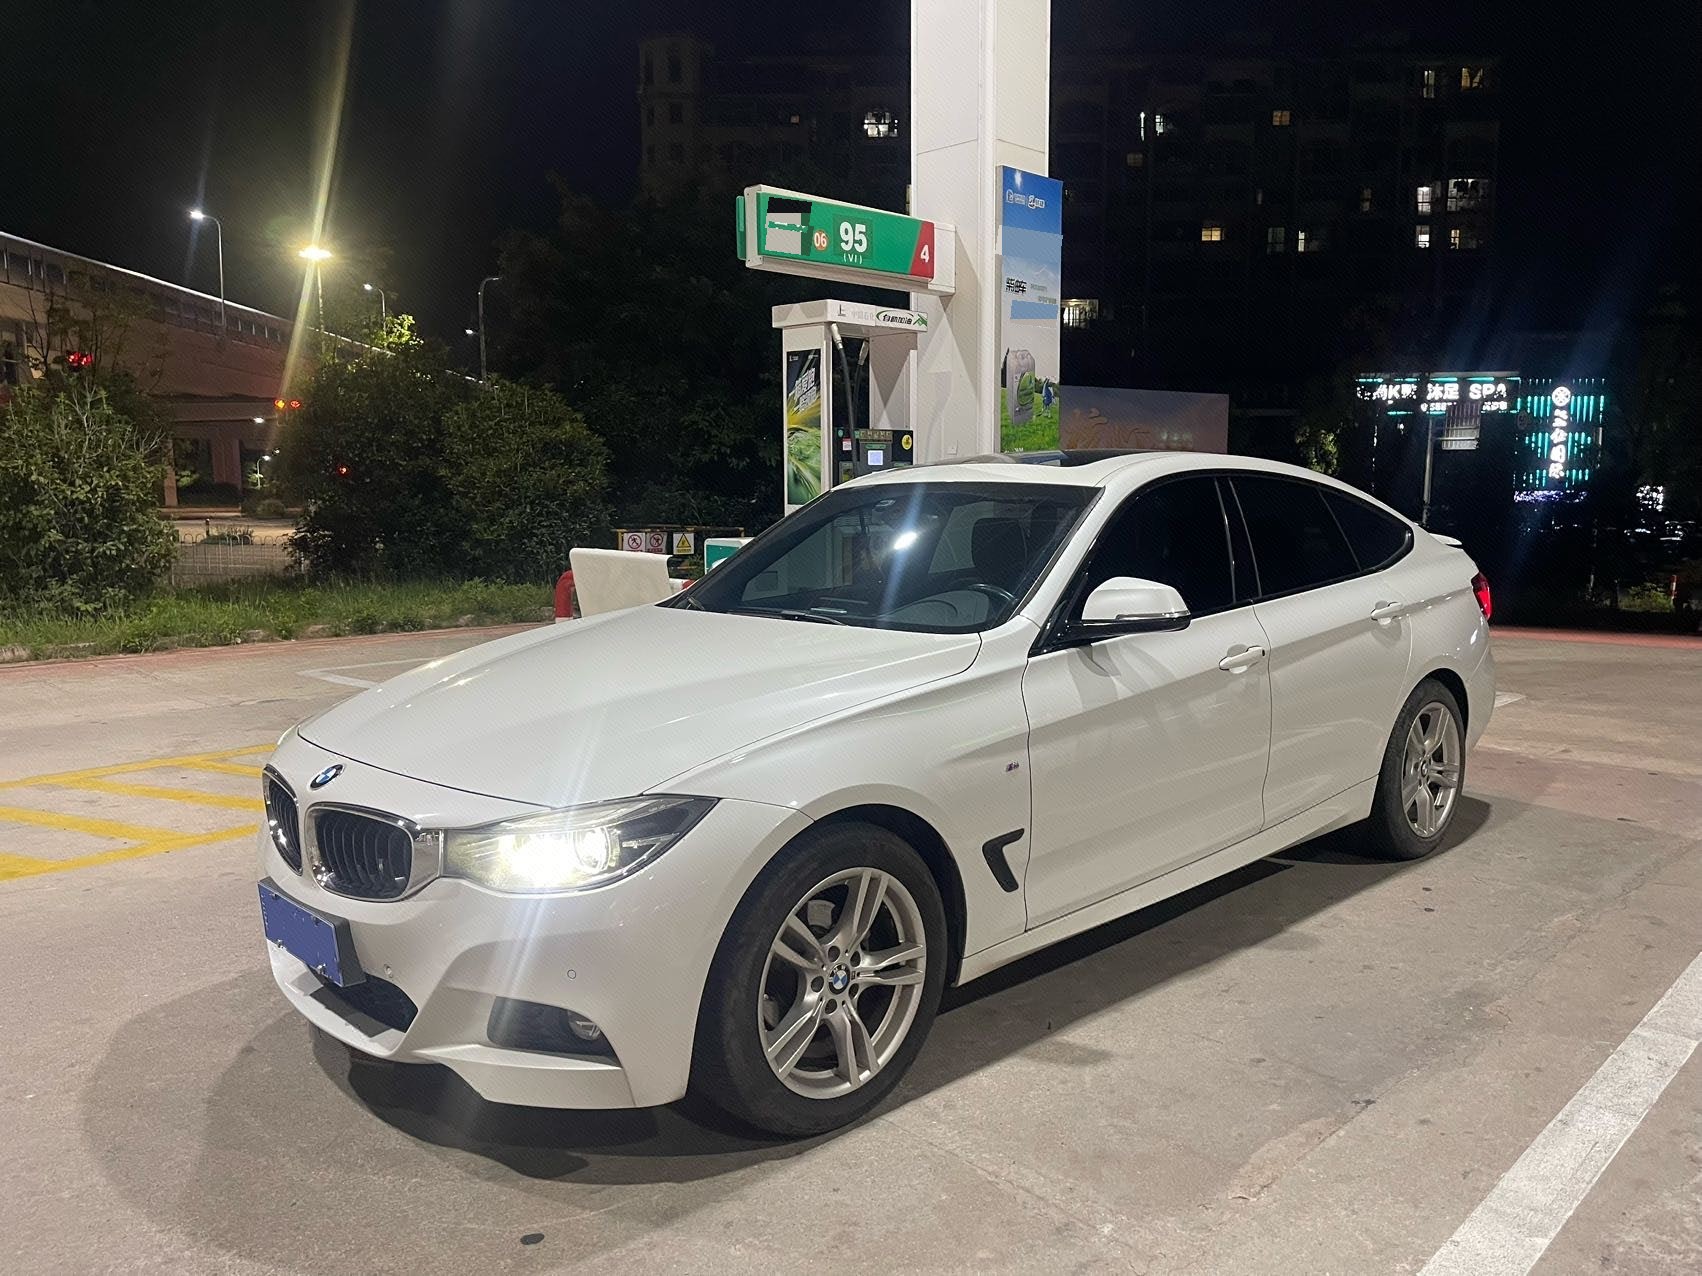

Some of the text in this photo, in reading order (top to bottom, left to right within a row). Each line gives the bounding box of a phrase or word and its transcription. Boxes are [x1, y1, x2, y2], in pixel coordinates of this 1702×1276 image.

[814, 231, 827, 248] 06
[839, 221, 868, 253] 95
[920, 244, 930, 263] 4
[1426, 383, 1460, 400] 沐足
[1469, 383, 1507, 399] SPA
